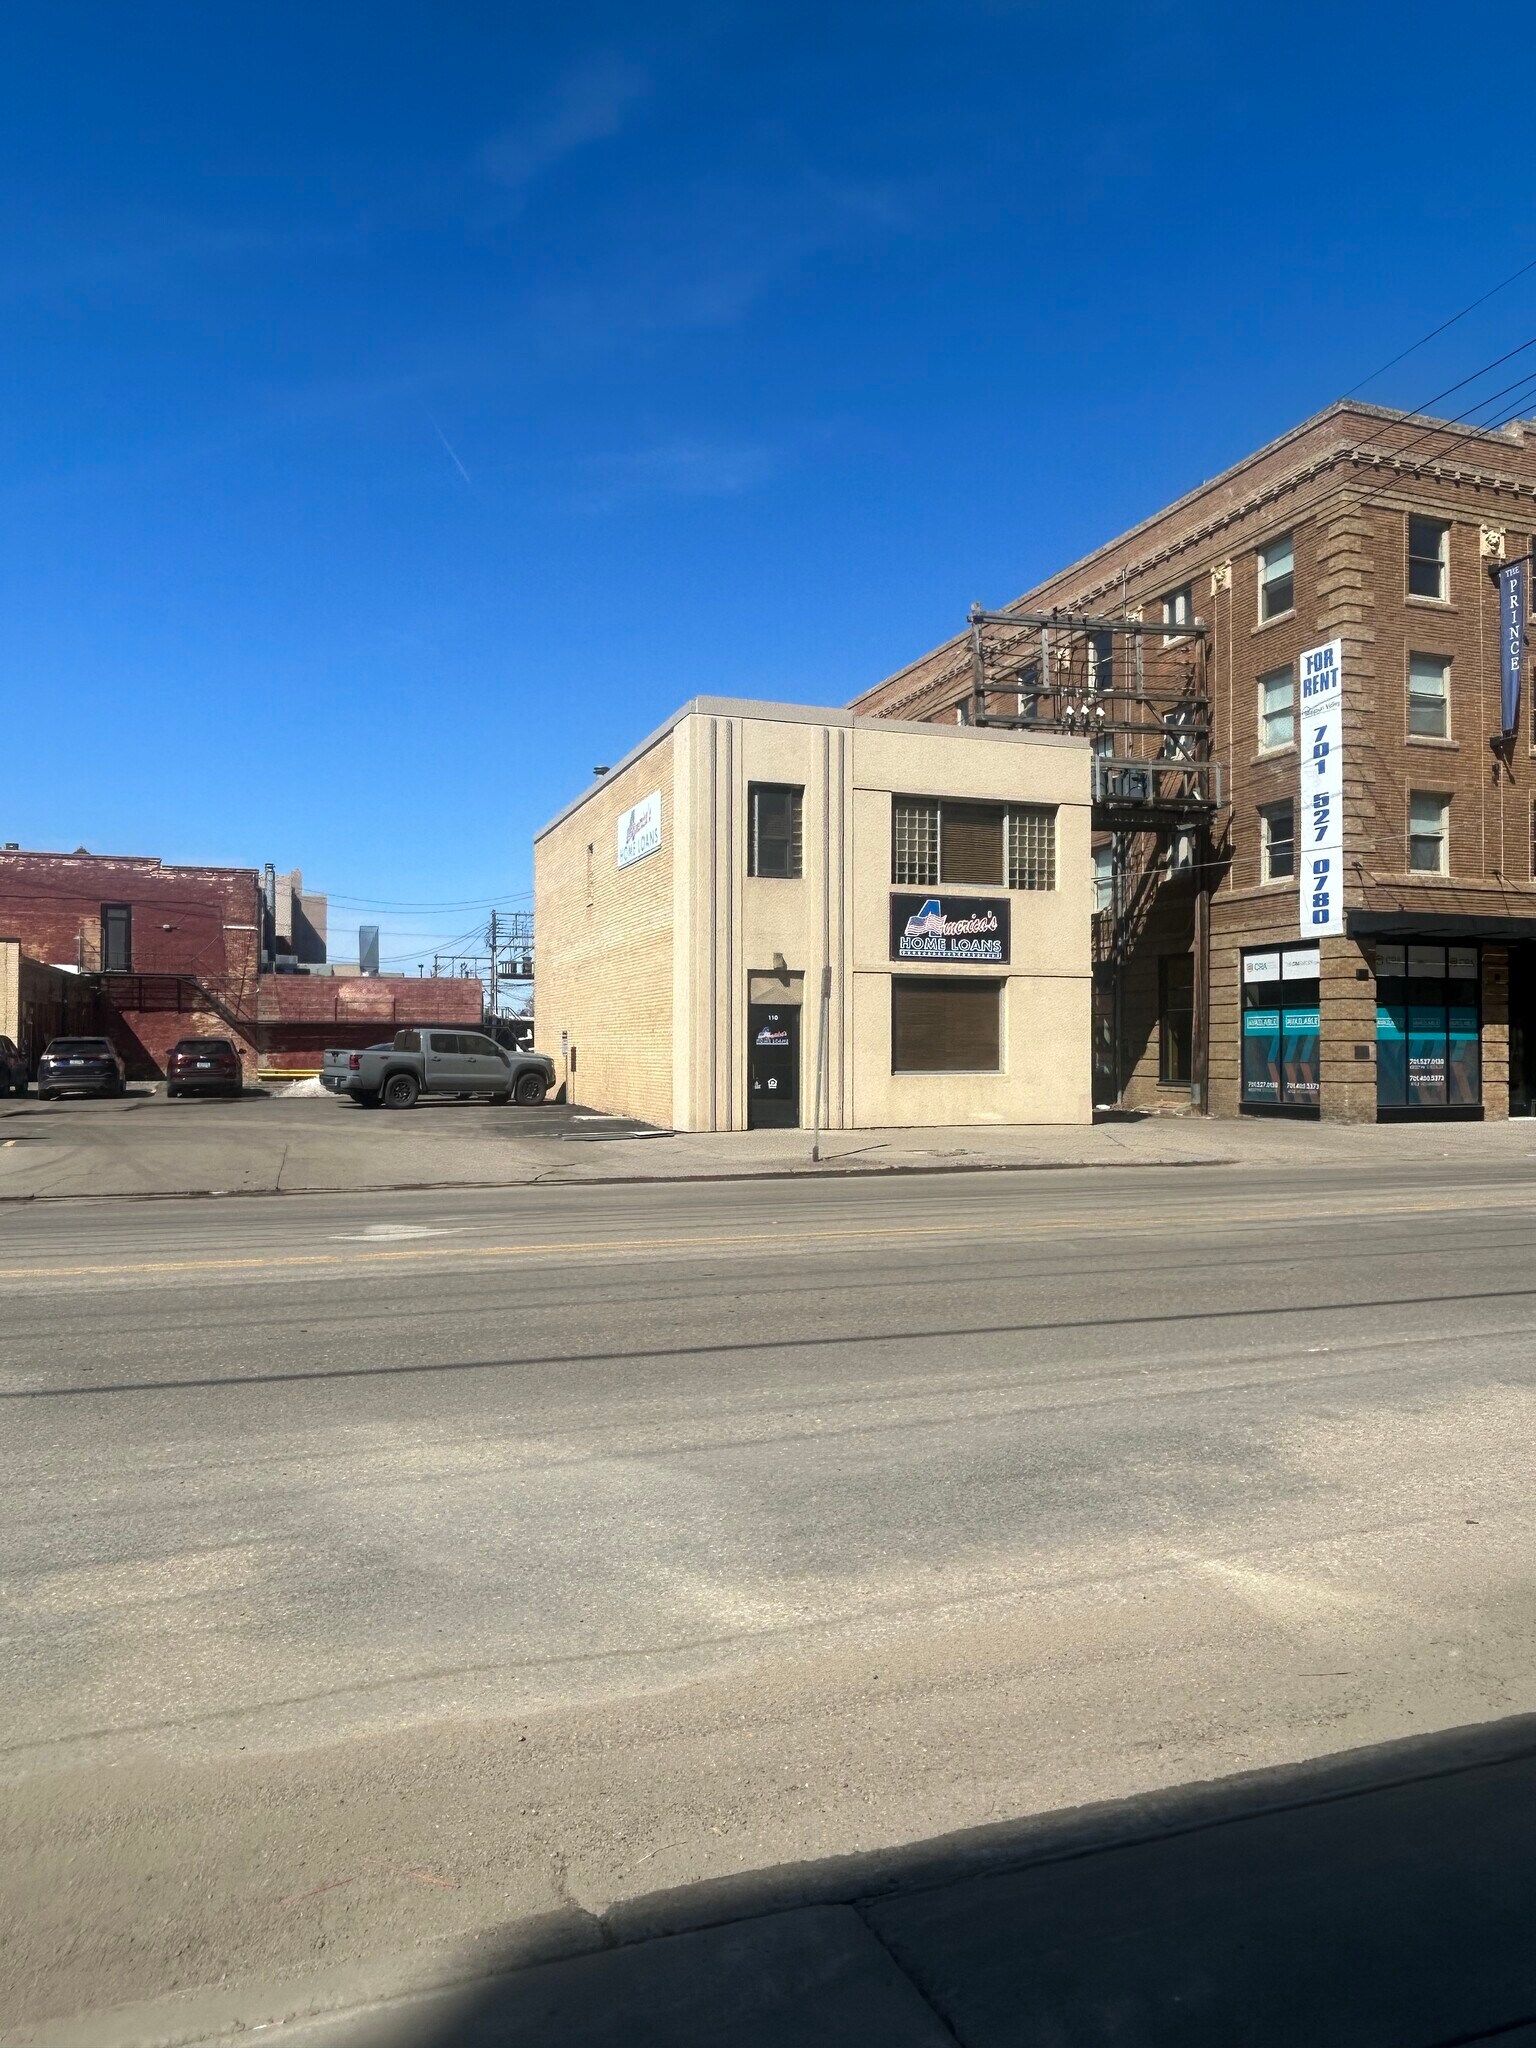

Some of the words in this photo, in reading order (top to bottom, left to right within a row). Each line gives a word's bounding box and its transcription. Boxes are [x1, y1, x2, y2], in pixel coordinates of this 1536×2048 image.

[1505, 566, 1520, 577] THE
[1509, 579, 1520, 671] PRINCE
[1307, 648, 1333, 675] FOR
[1303, 668, 1338, 698] RENT
[1313, 725, 1329, 774] 701
[1313, 792, 1330, 842] 527
[638, 828, 658, 854] LOANS
[1313, 859, 1330, 924] 0780
[905, 900, 998, 937] America's
[900, 937, 946, 950] HOME
[951, 939, 1002, 952] LOANS
